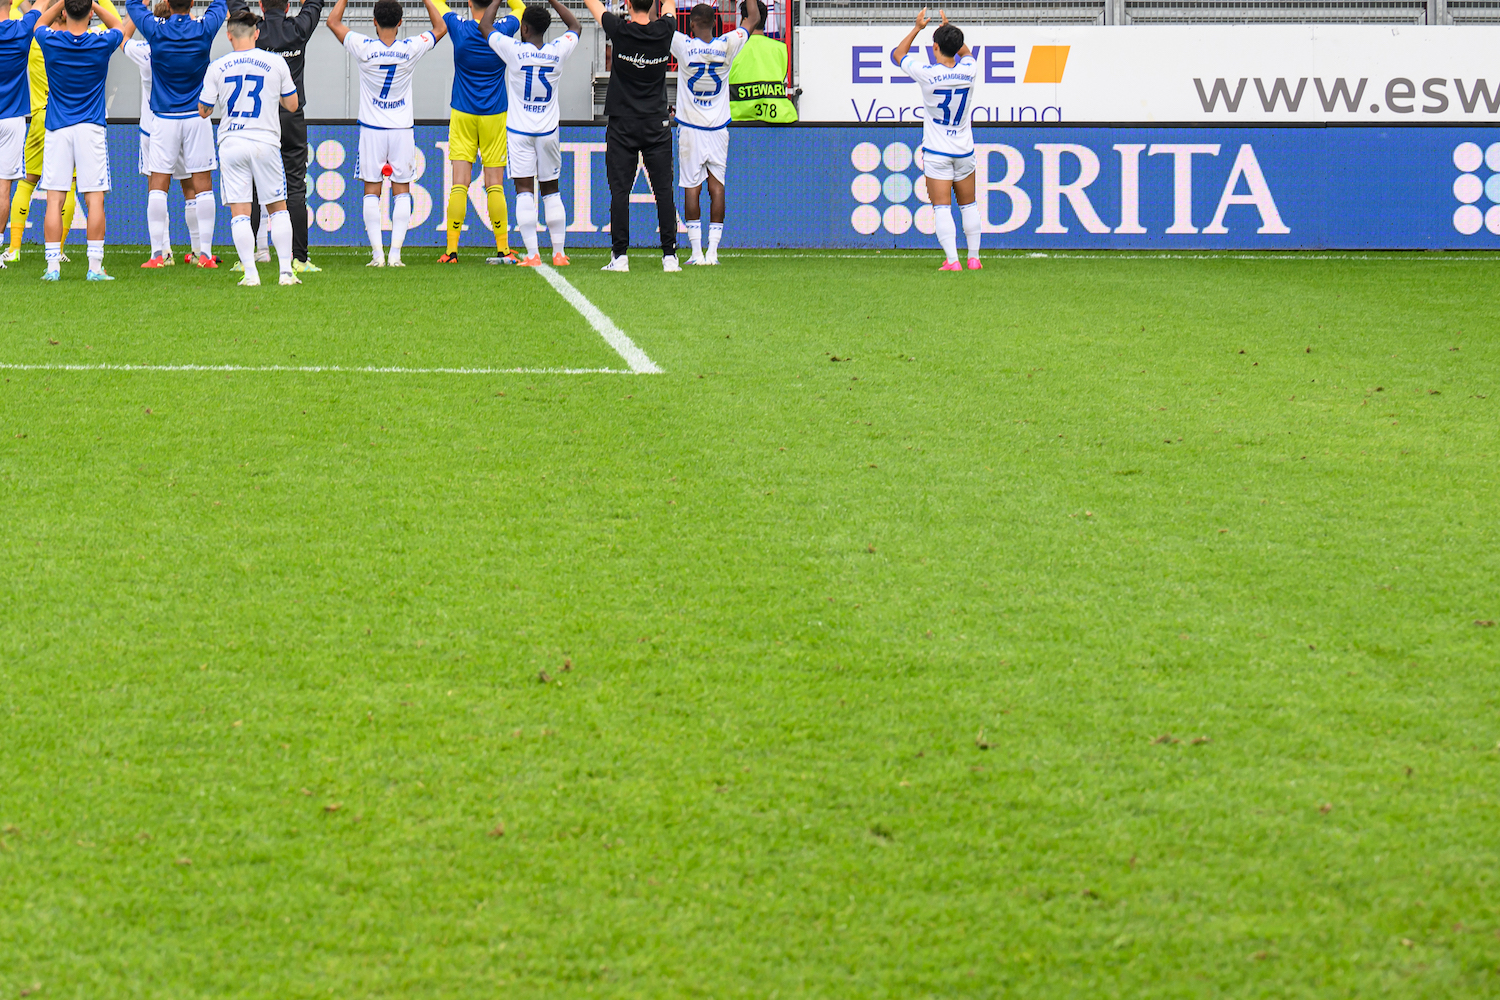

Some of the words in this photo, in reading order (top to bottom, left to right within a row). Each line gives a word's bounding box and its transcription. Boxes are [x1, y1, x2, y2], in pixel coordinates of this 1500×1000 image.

[233, 57, 272, 73] MAGDEBURG
[378, 64, 398, 99] 7
[687, 61, 725, 97] 25
[224, 74, 265, 119] 23
[520, 65, 554, 102] 15
[523, 103, 547, 114] HEBER
[754, 102, 778, 119] 378
[932, 86, 971, 126] 37
[974, 142, 1291, 235] BRITA
